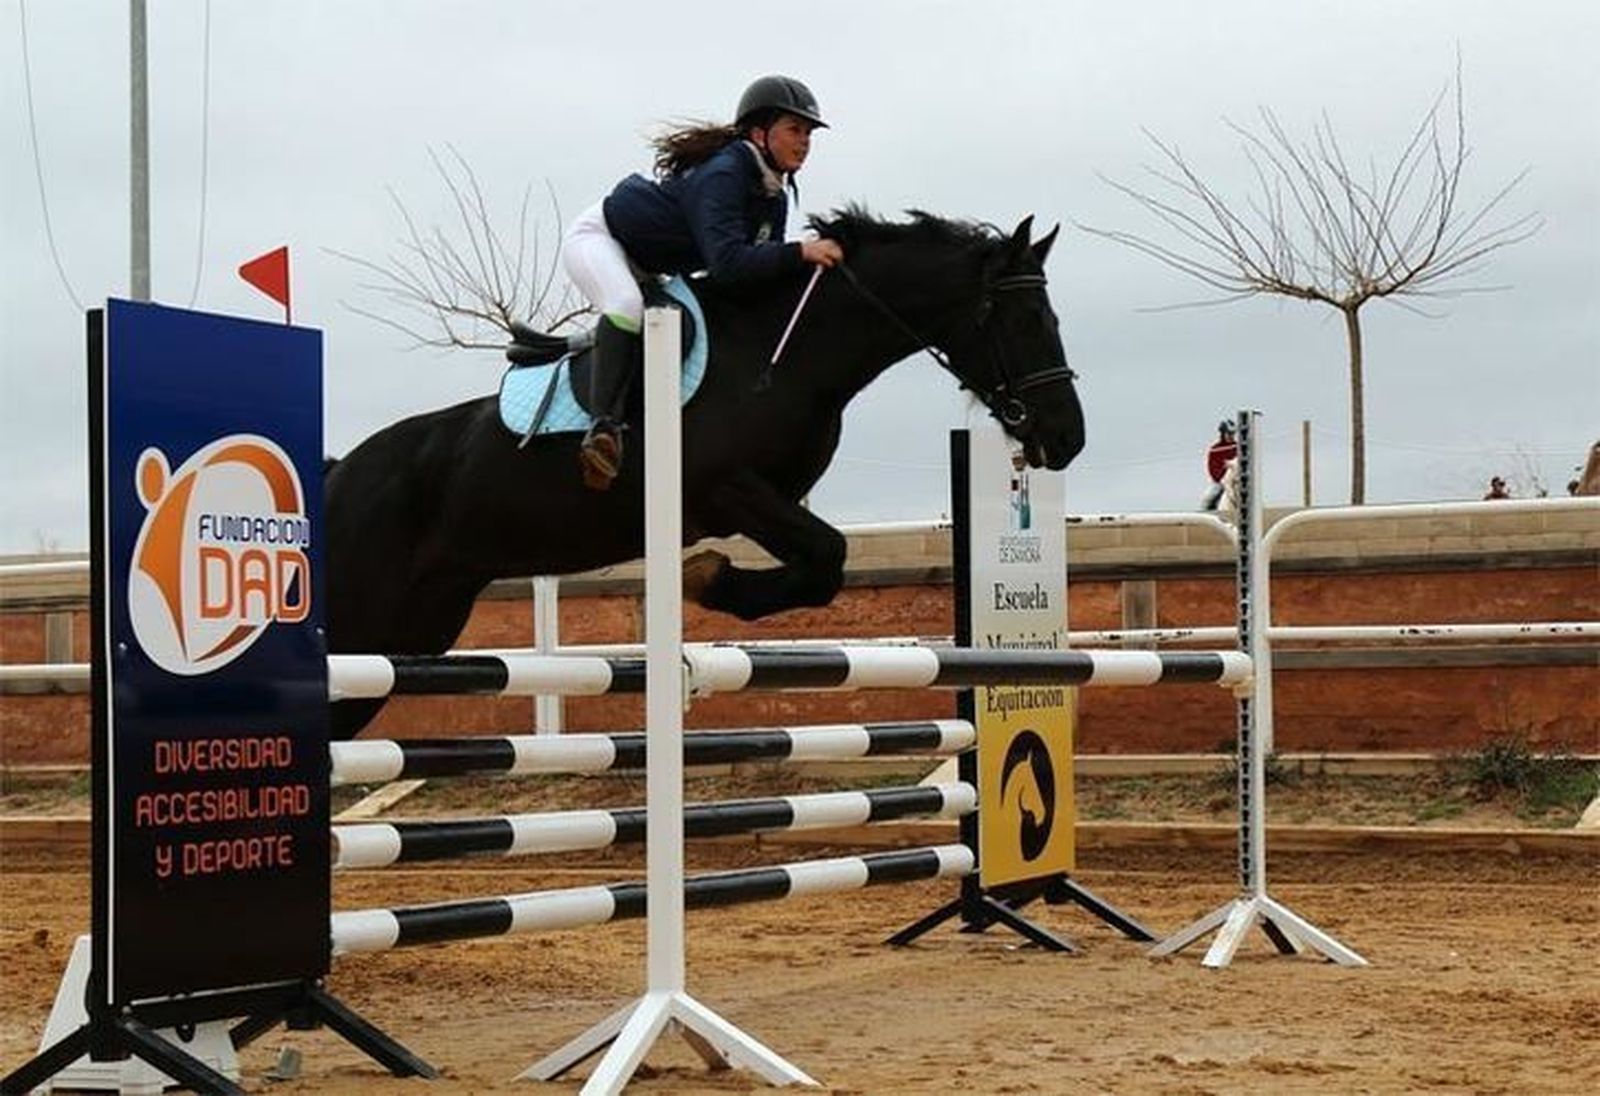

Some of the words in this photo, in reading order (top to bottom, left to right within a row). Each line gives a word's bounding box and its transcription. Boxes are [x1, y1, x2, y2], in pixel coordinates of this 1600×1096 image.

[199, 547, 309, 620] DAD
[994, 583, 1049, 610] Escuela
[155, 737, 292, 773] DIVERSIDAD
[136, 785, 310, 827] ACCESIBILIDAD
[183, 835, 293, 875] DEPORTE
